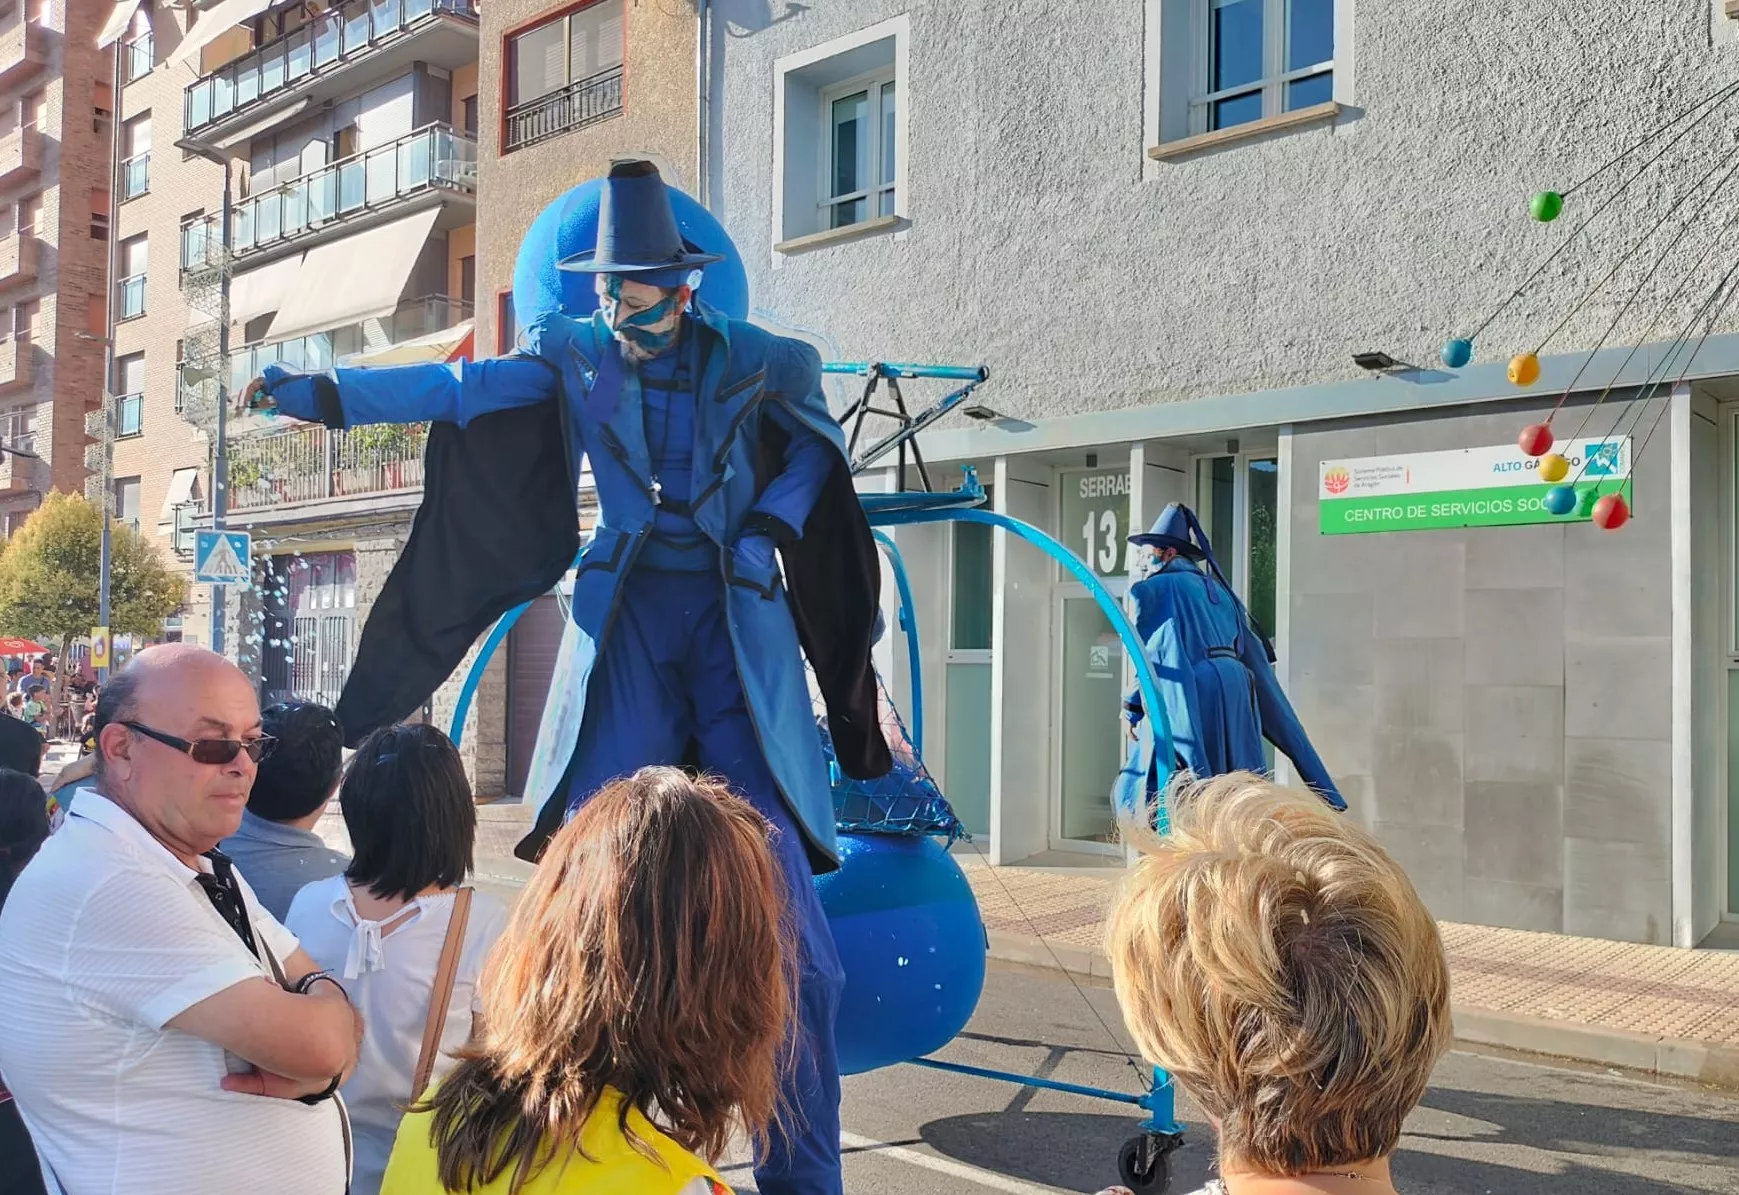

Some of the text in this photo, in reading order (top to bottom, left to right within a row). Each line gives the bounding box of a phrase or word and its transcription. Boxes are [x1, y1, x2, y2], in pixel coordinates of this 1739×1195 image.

[1492, 461, 1522, 472] ALTO
[1079, 473, 1132, 499] SERRAB
[1344, 507, 1404, 522] CENTRO
[1407, 505, 1427, 518] DE
[1431, 499, 1513, 517] SERVICIOS
